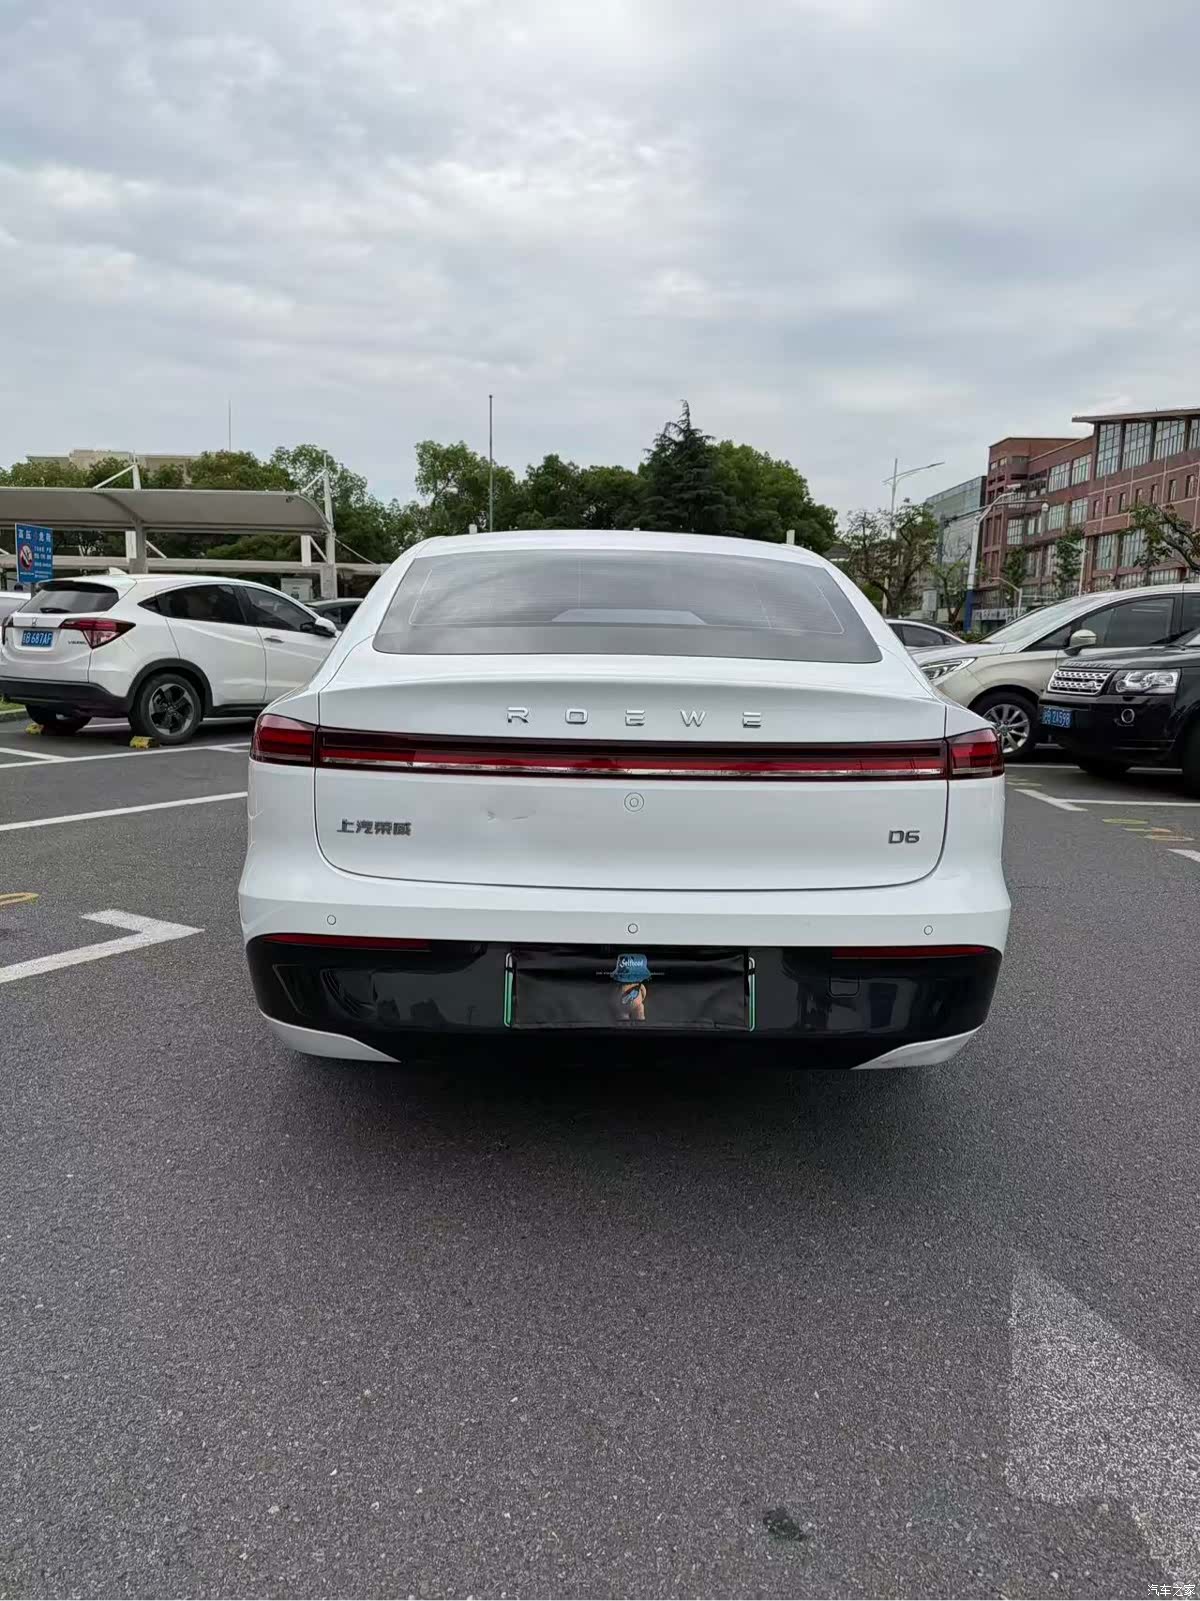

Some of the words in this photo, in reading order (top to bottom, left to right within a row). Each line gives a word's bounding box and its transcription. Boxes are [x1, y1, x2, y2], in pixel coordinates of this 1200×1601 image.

[507, 706, 762, 729] ROEWE
[336, 818, 412, 836] 上汽荣威
[888, 830, 920, 843] D6
